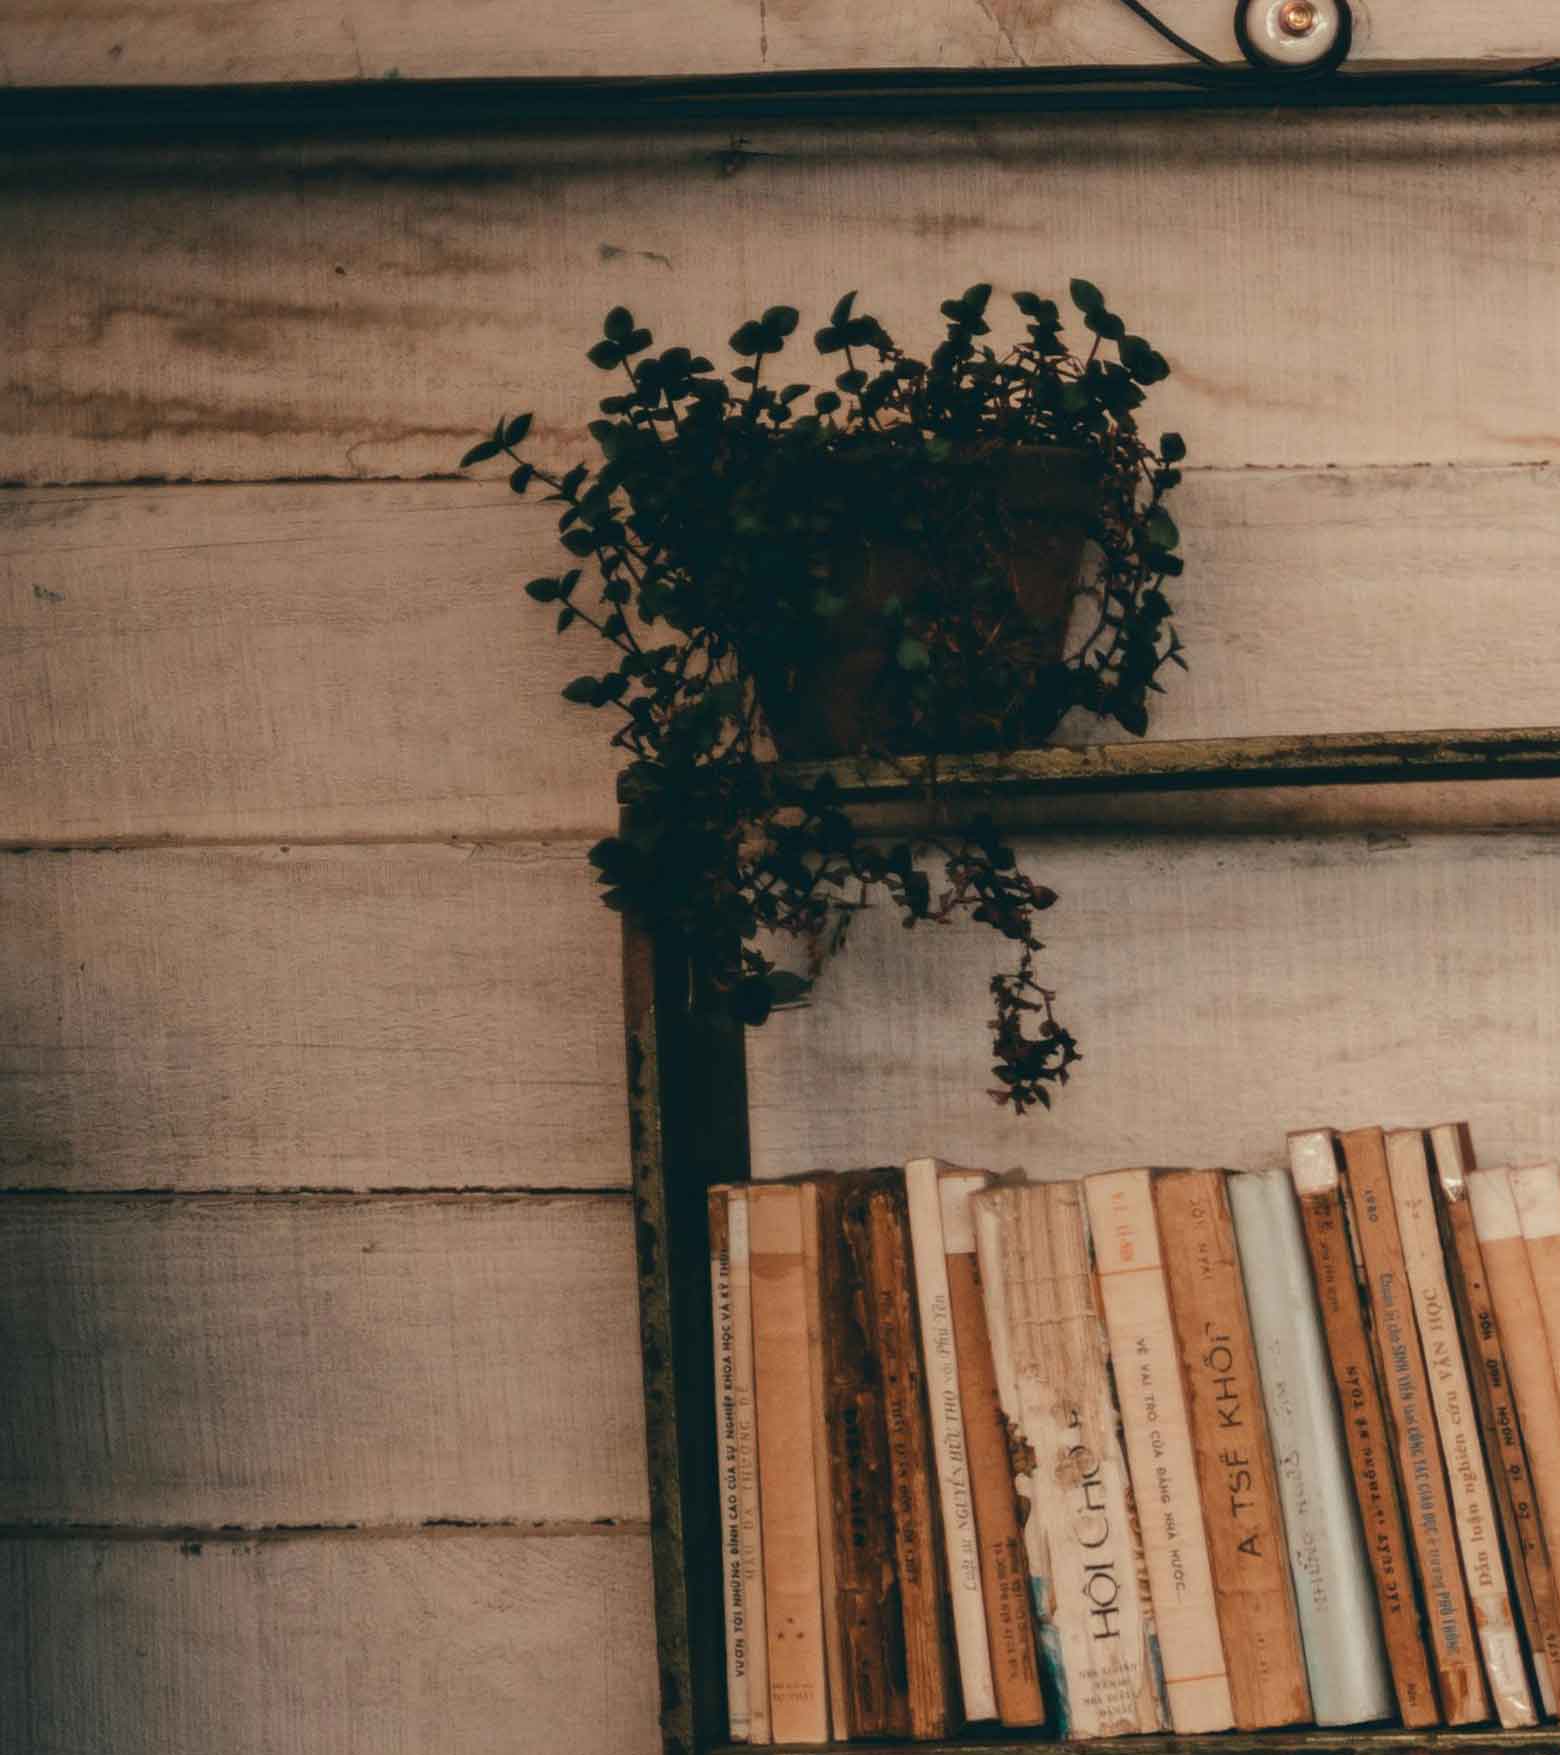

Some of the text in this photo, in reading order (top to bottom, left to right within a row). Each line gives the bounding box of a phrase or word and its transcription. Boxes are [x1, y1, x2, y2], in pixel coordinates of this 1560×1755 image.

[717, 1301, 731, 1321] VÀ
[1420, 1285, 1446, 1331] HỌC
[720, 1323, 735, 1352] HỌC
[720, 1354, 733, 1392] KHOA
[1426, 1336, 1455, 1382] VĂN
[722, 1464, 737, 1491] CỦA
[726, 1493, 738, 1521] CAO
[1077, 1560, 1129, 1642] HỘI
